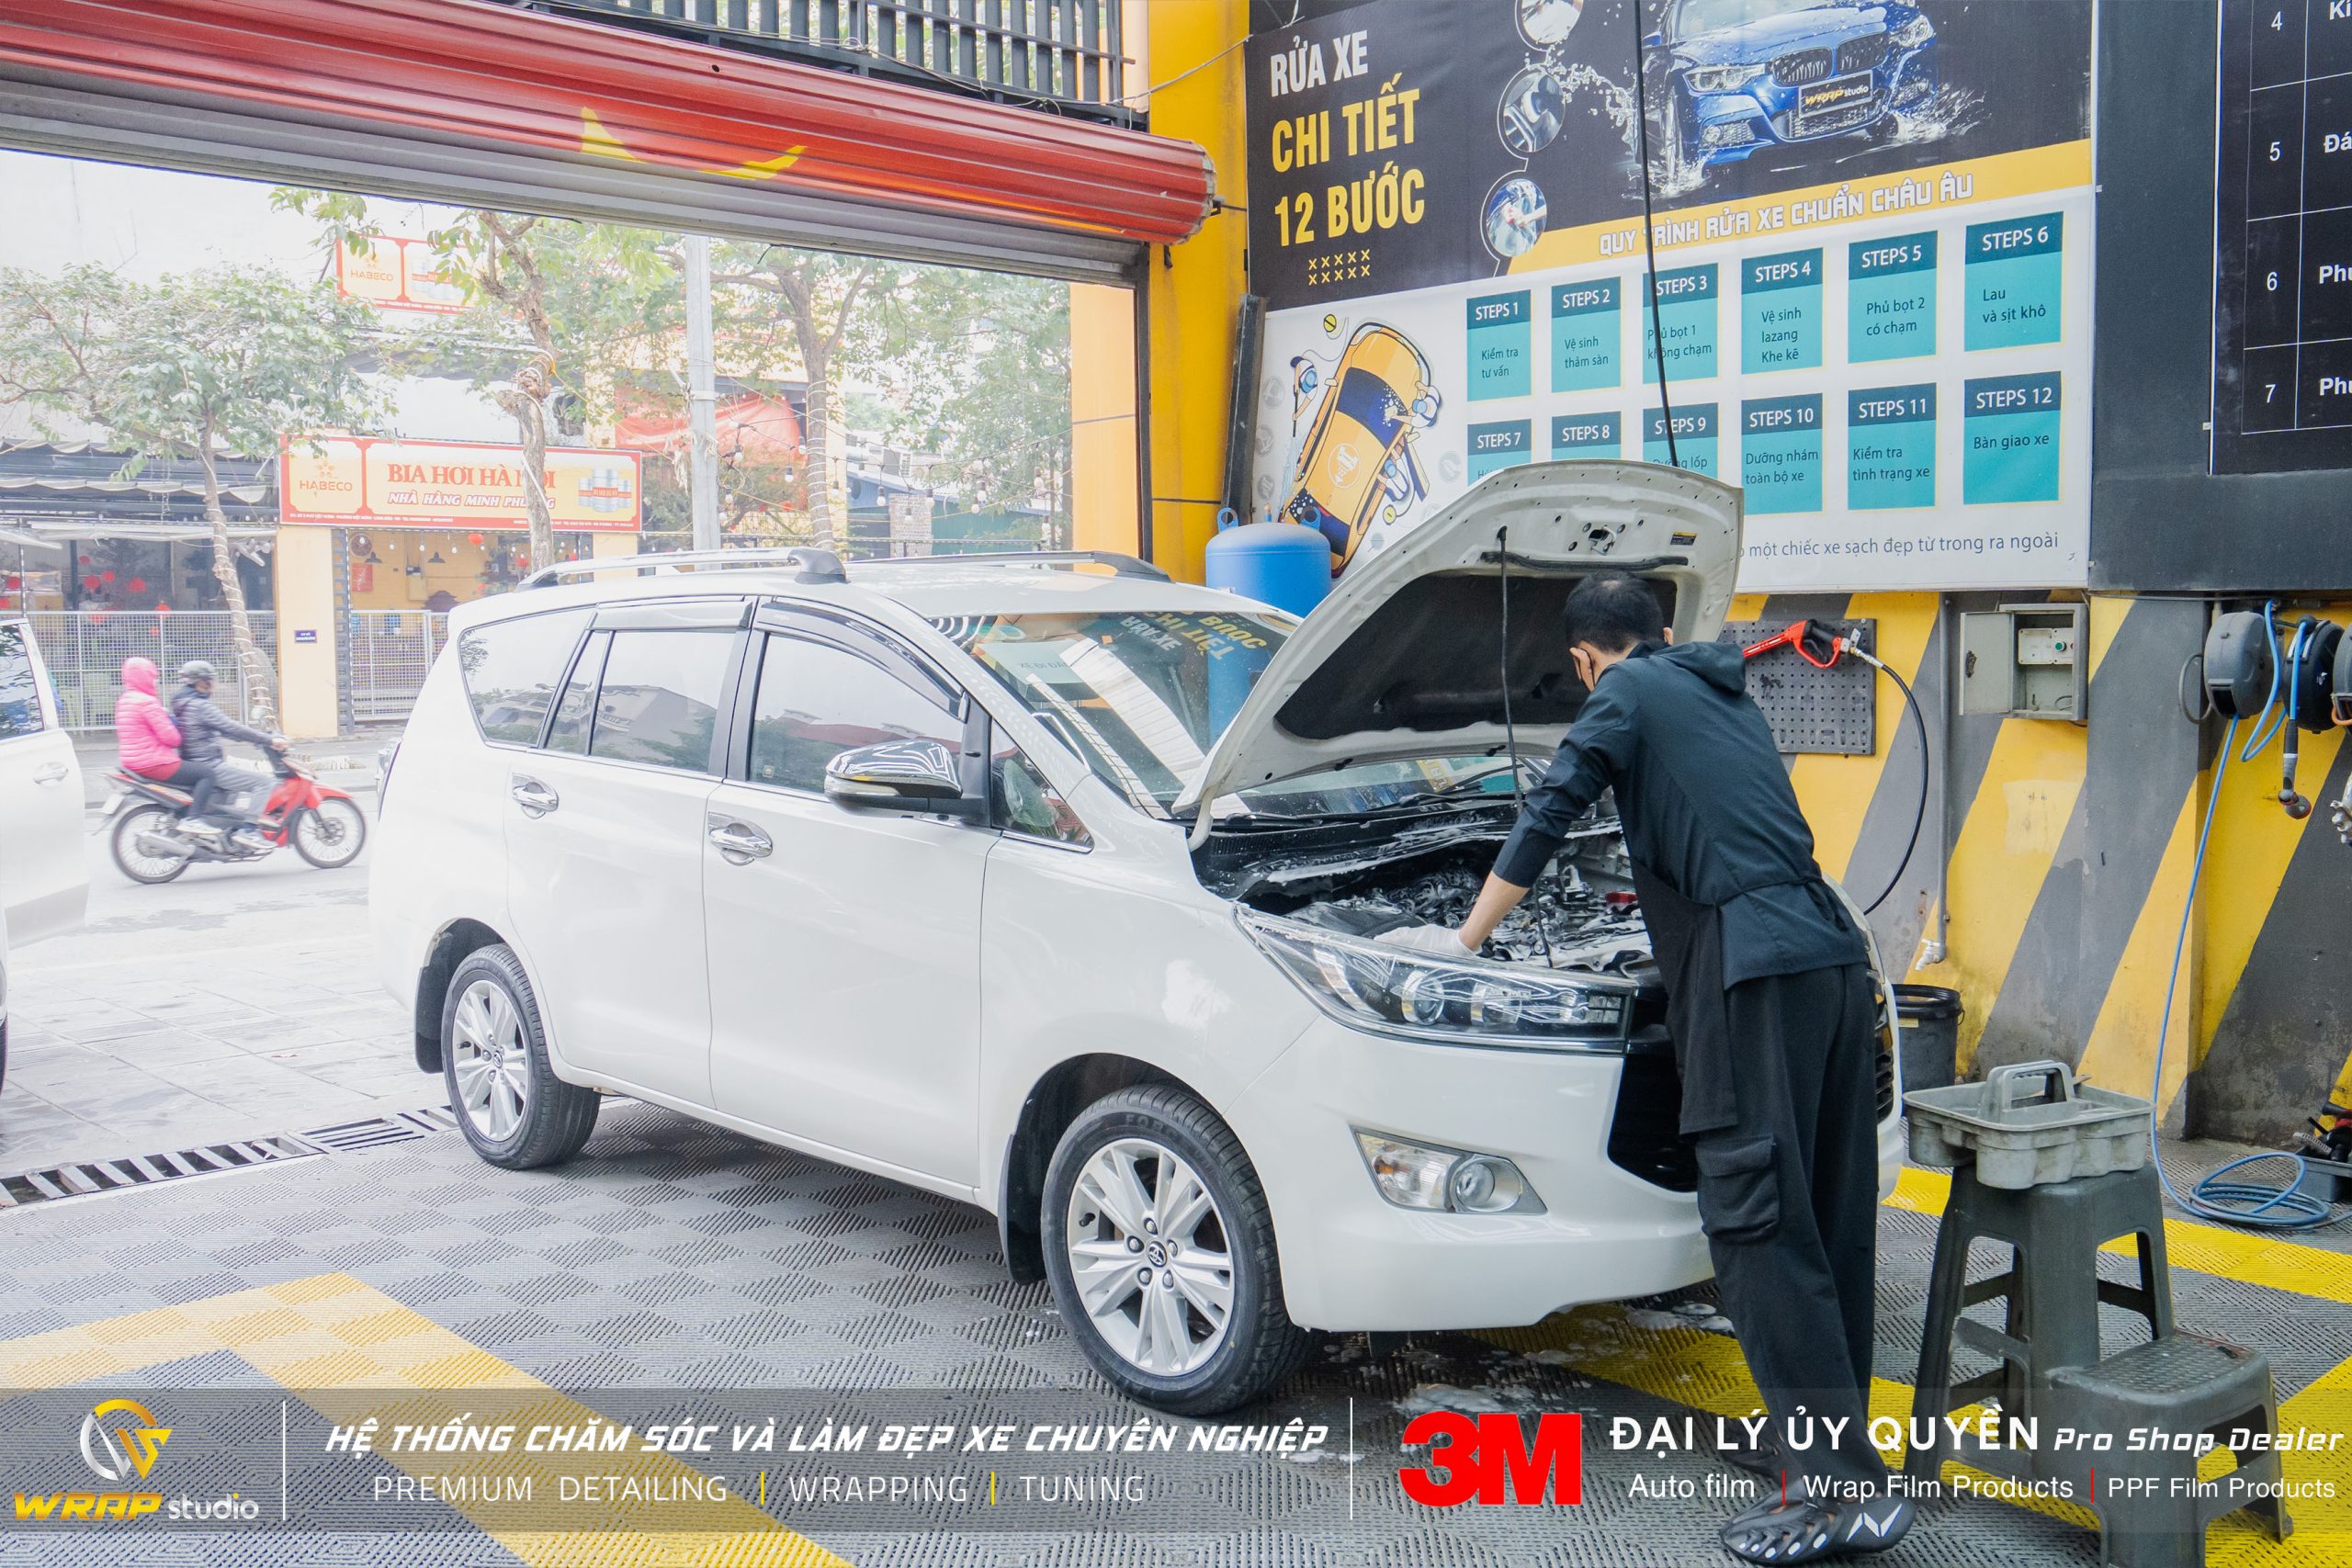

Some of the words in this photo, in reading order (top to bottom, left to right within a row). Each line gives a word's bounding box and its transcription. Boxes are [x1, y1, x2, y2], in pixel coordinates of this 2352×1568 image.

[2270, 11, 2283, 32] 4
[1270, 34, 1326, 97] RỬA
[1334, 29, 1369, 83] XE
[1272, 110, 1330, 173] CHI
[1341, 73, 1420, 157] TIẾT
[2268, 141, 2280, 162] 5
[1273, 191, 1315, 247] 12
[1328, 161, 1426, 239] BƯỚC
[1600, 230, 1637, 256] QUY
[1643, 218, 1700, 247] RÌNH
[1705, 207, 1750, 239] RỬA
[1757, 205, 1784, 231] XE
[1791, 184, 1864, 226] CHUẨN
[1871, 177, 1932, 213] CHÂU
[1939, 170, 1973, 202] ÂU
[1982, 227, 2033, 252] STEPS
[2037, 225, 2049, 243] 6
[1861, 245, 1908, 268] STEPS
[1912, 244, 1922, 262] 5
[350, 269, 394, 282] HABECO
[1755, 262, 1799, 283] STEPS
[1802, 260, 1812, 276] 4
[1656, 276, 1696, 297] STEPS
[1699, 275, 1707, 290] 3
[2266, 271, 2278, 292] 6
[1562, 290, 1600, 309] STEPS
[1602, 288, 1611, 304] 2
[1983, 288, 2006, 301] Lau
[1476, 302, 1510, 321] STEPS
[1513, 301, 1519, 315] 1
[1866, 299, 1890, 315] Phủ
[1894, 299, 1915, 313] bọt
[1917, 297, 1925, 309] 2
[1982, 310, 1996, 323] và
[2001, 308, 2017, 323] sịt
[2021, 304, 2046, 319] khô
[1761, 310, 1775, 324] Vệ
[1778, 307, 1802, 321] sinh
[1647, 327, 1668, 341] Pủ
[1670, 326, 1688, 340] bọt
[1691, 324, 1696, 335] 1
[1866, 323, 1881, 336] có
[1883, 321, 1917, 335] chạm
[1565, 339, 1577, 352] Vệ
[1578, 335, 1599, 348] sinh
[1762, 331, 1798, 344] lazang
[1481, 347, 1504, 361] Kiểm
[1507, 348, 1519, 358] tra
[1683, 344, 1712, 356] chạm
[1762, 350, 1782, 363] Khe
[1565, 356, 1589, 368] thảm
[1482, 369, 1491, 378] tư
[1493, 365, 1510, 377] vấn
[1976, 389, 2027, 410] STEPS
[2032, 387, 2052, 404] 12
[2264, 383, 2277, 403] 7
[1859, 400, 1905, 419] STEPS
[1910, 398, 1926, 414] 11
[1698, 416, 1706, 432] 9
[1749, 409, 1792, 428] STEPS
[1796, 408, 1815, 423] 10
[1476, 433, 1511, 449] STEPS
[1514, 432, 1521, 446] 7
[1562, 424, 1599, 442] STEPS
[1601, 424, 1610, 439] 8
[1973, 436, 1997, 449] Bàn
[2001, 434, 2030, 450] giao
[2034, 434, 2050, 445] xe
[1746, 449, 1782, 466] Dưỡng
[1786, 449, 1818, 461] nhám
[1853, 446, 1883, 460] Kiểm
[1886, 447, 1903, 458] tra
[1690, 455, 1708, 469] lốp
[388, 463, 427, 483] BIA
[479, 464, 512, 487] HÀ
[1746, 472, 1770, 484] toàn
[1774, 470, 1788, 485] bộ
[1792, 472, 1804, 481] xe
[1853, 468, 1876, 481] tình
[1880, 468, 1912, 482] trạng
[1916, 468, 1929, 478] xe
[300, 479, 353, 491] HABECO
[388, 490, 419, 504] NHÀ
[423, 491, 460, 506] HÀNG
[464, 494, 499, 507] MINH
[1749, 541, 1778, 559] một
[1781, 538, 1819, 556] chiếc
[1824, 542, 1840, 554] xe
[1845, 537, 1878, 558] sạch
[1883, 536, 1913, 557] đẹp
[1918, 536, 1936, 551] từ
[1939, 537, 1984, 554] trong
[1989, 537, 2005, 549] ra
[2010, 532, 2058, 553] ngoài
